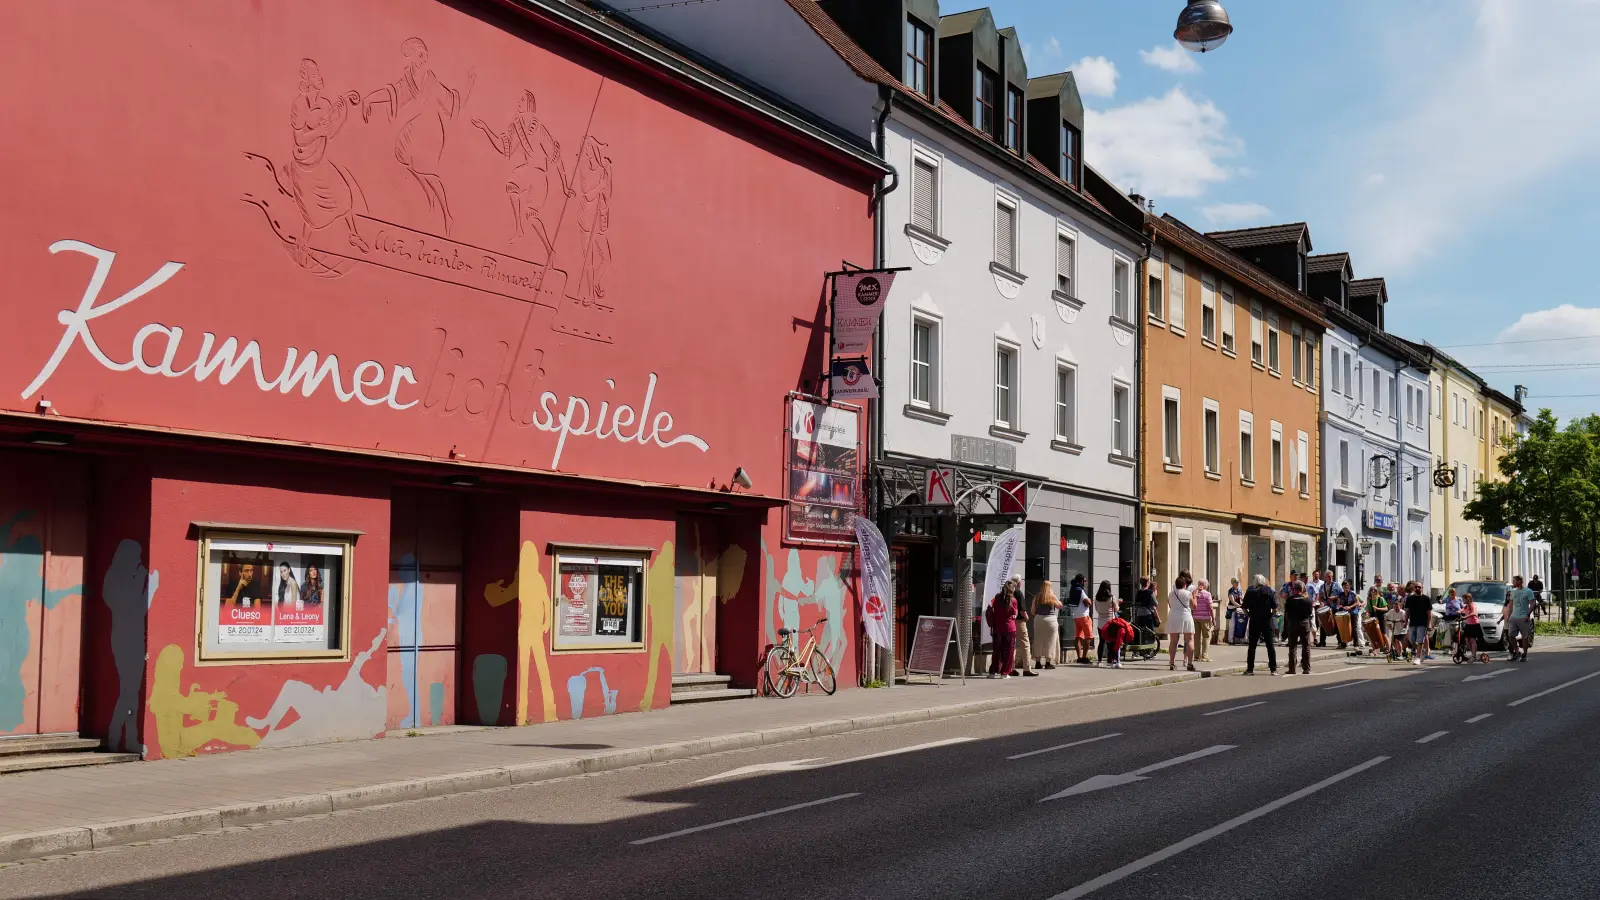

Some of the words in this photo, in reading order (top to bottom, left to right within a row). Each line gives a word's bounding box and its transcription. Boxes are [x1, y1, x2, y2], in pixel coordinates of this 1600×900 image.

[928, 470, 951, 504] K
[999, 537, 1015, 592] ammerspiele
[604, 575, 624, 588] THE
[231, 608, 261, 620] Clueso
[603, 602, 625, 616] YOU
[279, 613, 295, 621] Lena
[295, 612, 300, 621] &
[301, 613, 320, 622] Leony
